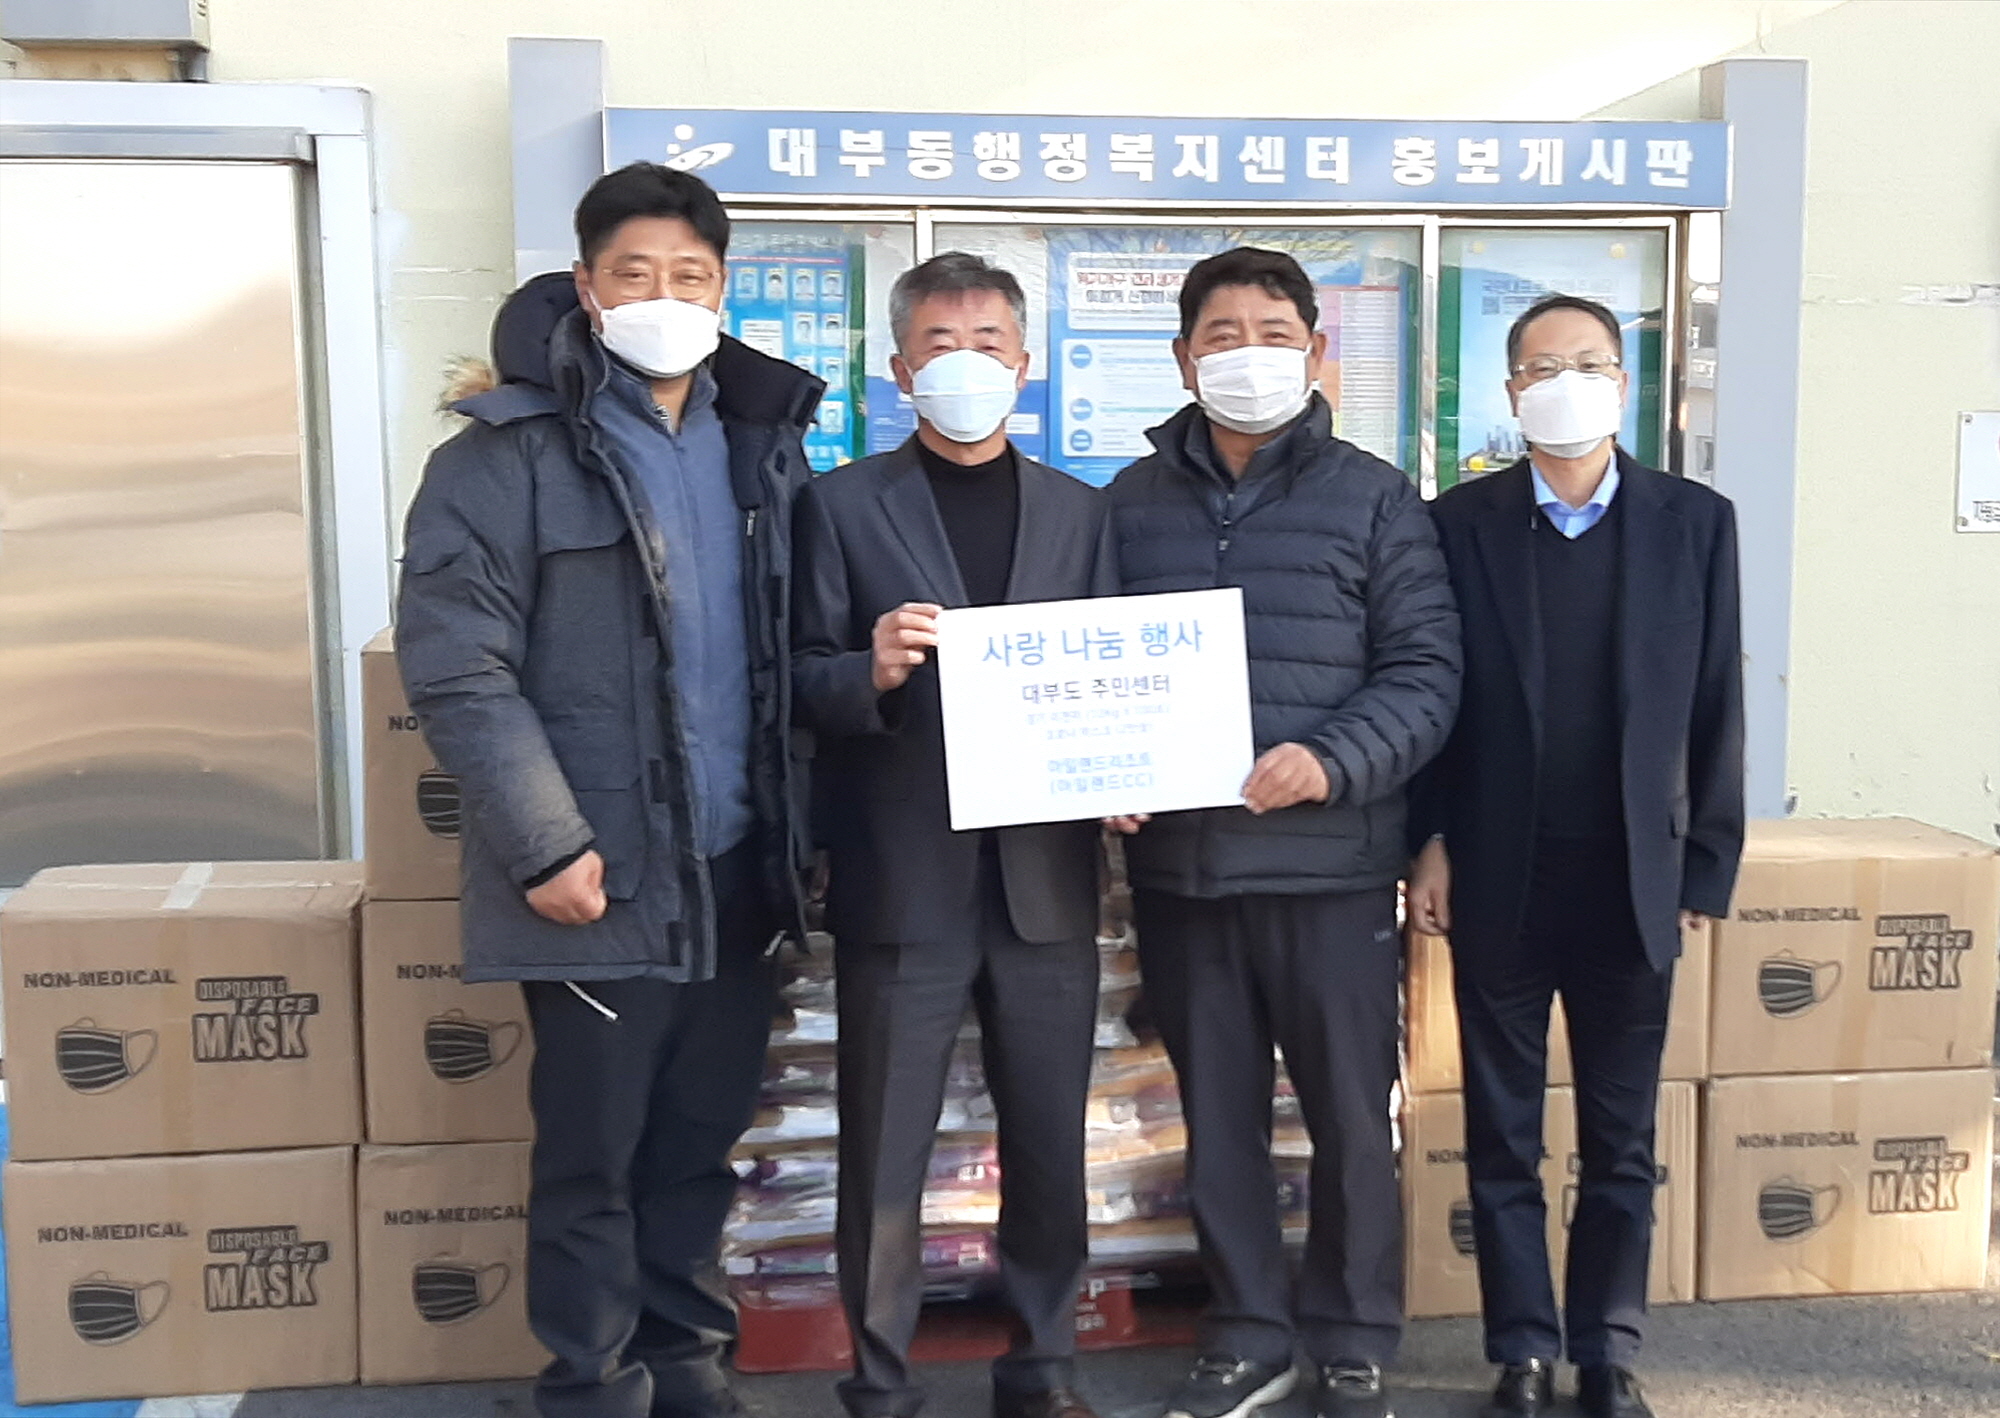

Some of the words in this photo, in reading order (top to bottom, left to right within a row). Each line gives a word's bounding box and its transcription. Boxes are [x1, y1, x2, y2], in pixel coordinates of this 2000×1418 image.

[768, 128, 1350, 184] 대부동행정복지센터
[1391, 136, 1693, 188] 홍보게시판
[982, 630, 1047, 667] 사랑
[1062, 627, 1125, 661] 나눔
[1139, 620, 1203, 657] 행사
[1022, 680, 1083, 704] 대부도
[1091, 674, 1171, 699] 주민센터
[1738, 907, 1861, 922] NON-MEDICAL
[1907, 930, 1972, 949] FACE
[23, 968, 177, 988] NON-MEDICAL
[1869, 947, 1961, 990] MASK
[196, 977, 288, 1000] DISPOSABLE
[236, 995, 318, 1014] FACE
[193, 1013, 307, 1062] MASK
[1736, 1131, 1859, 1148] NON-MEDICAL
[1869, 1170, 1959, 1213] MASK
[384, 1204, 530, 1226] NON-MEDICAL
[37, 1222, 189, 1243] NON-MEDICAL
[208, 1226, 299, 1251] DISPOSABLE
[246, 1242, 328, 1263] FACE
[203, 1262, 317, 1312] MASK
